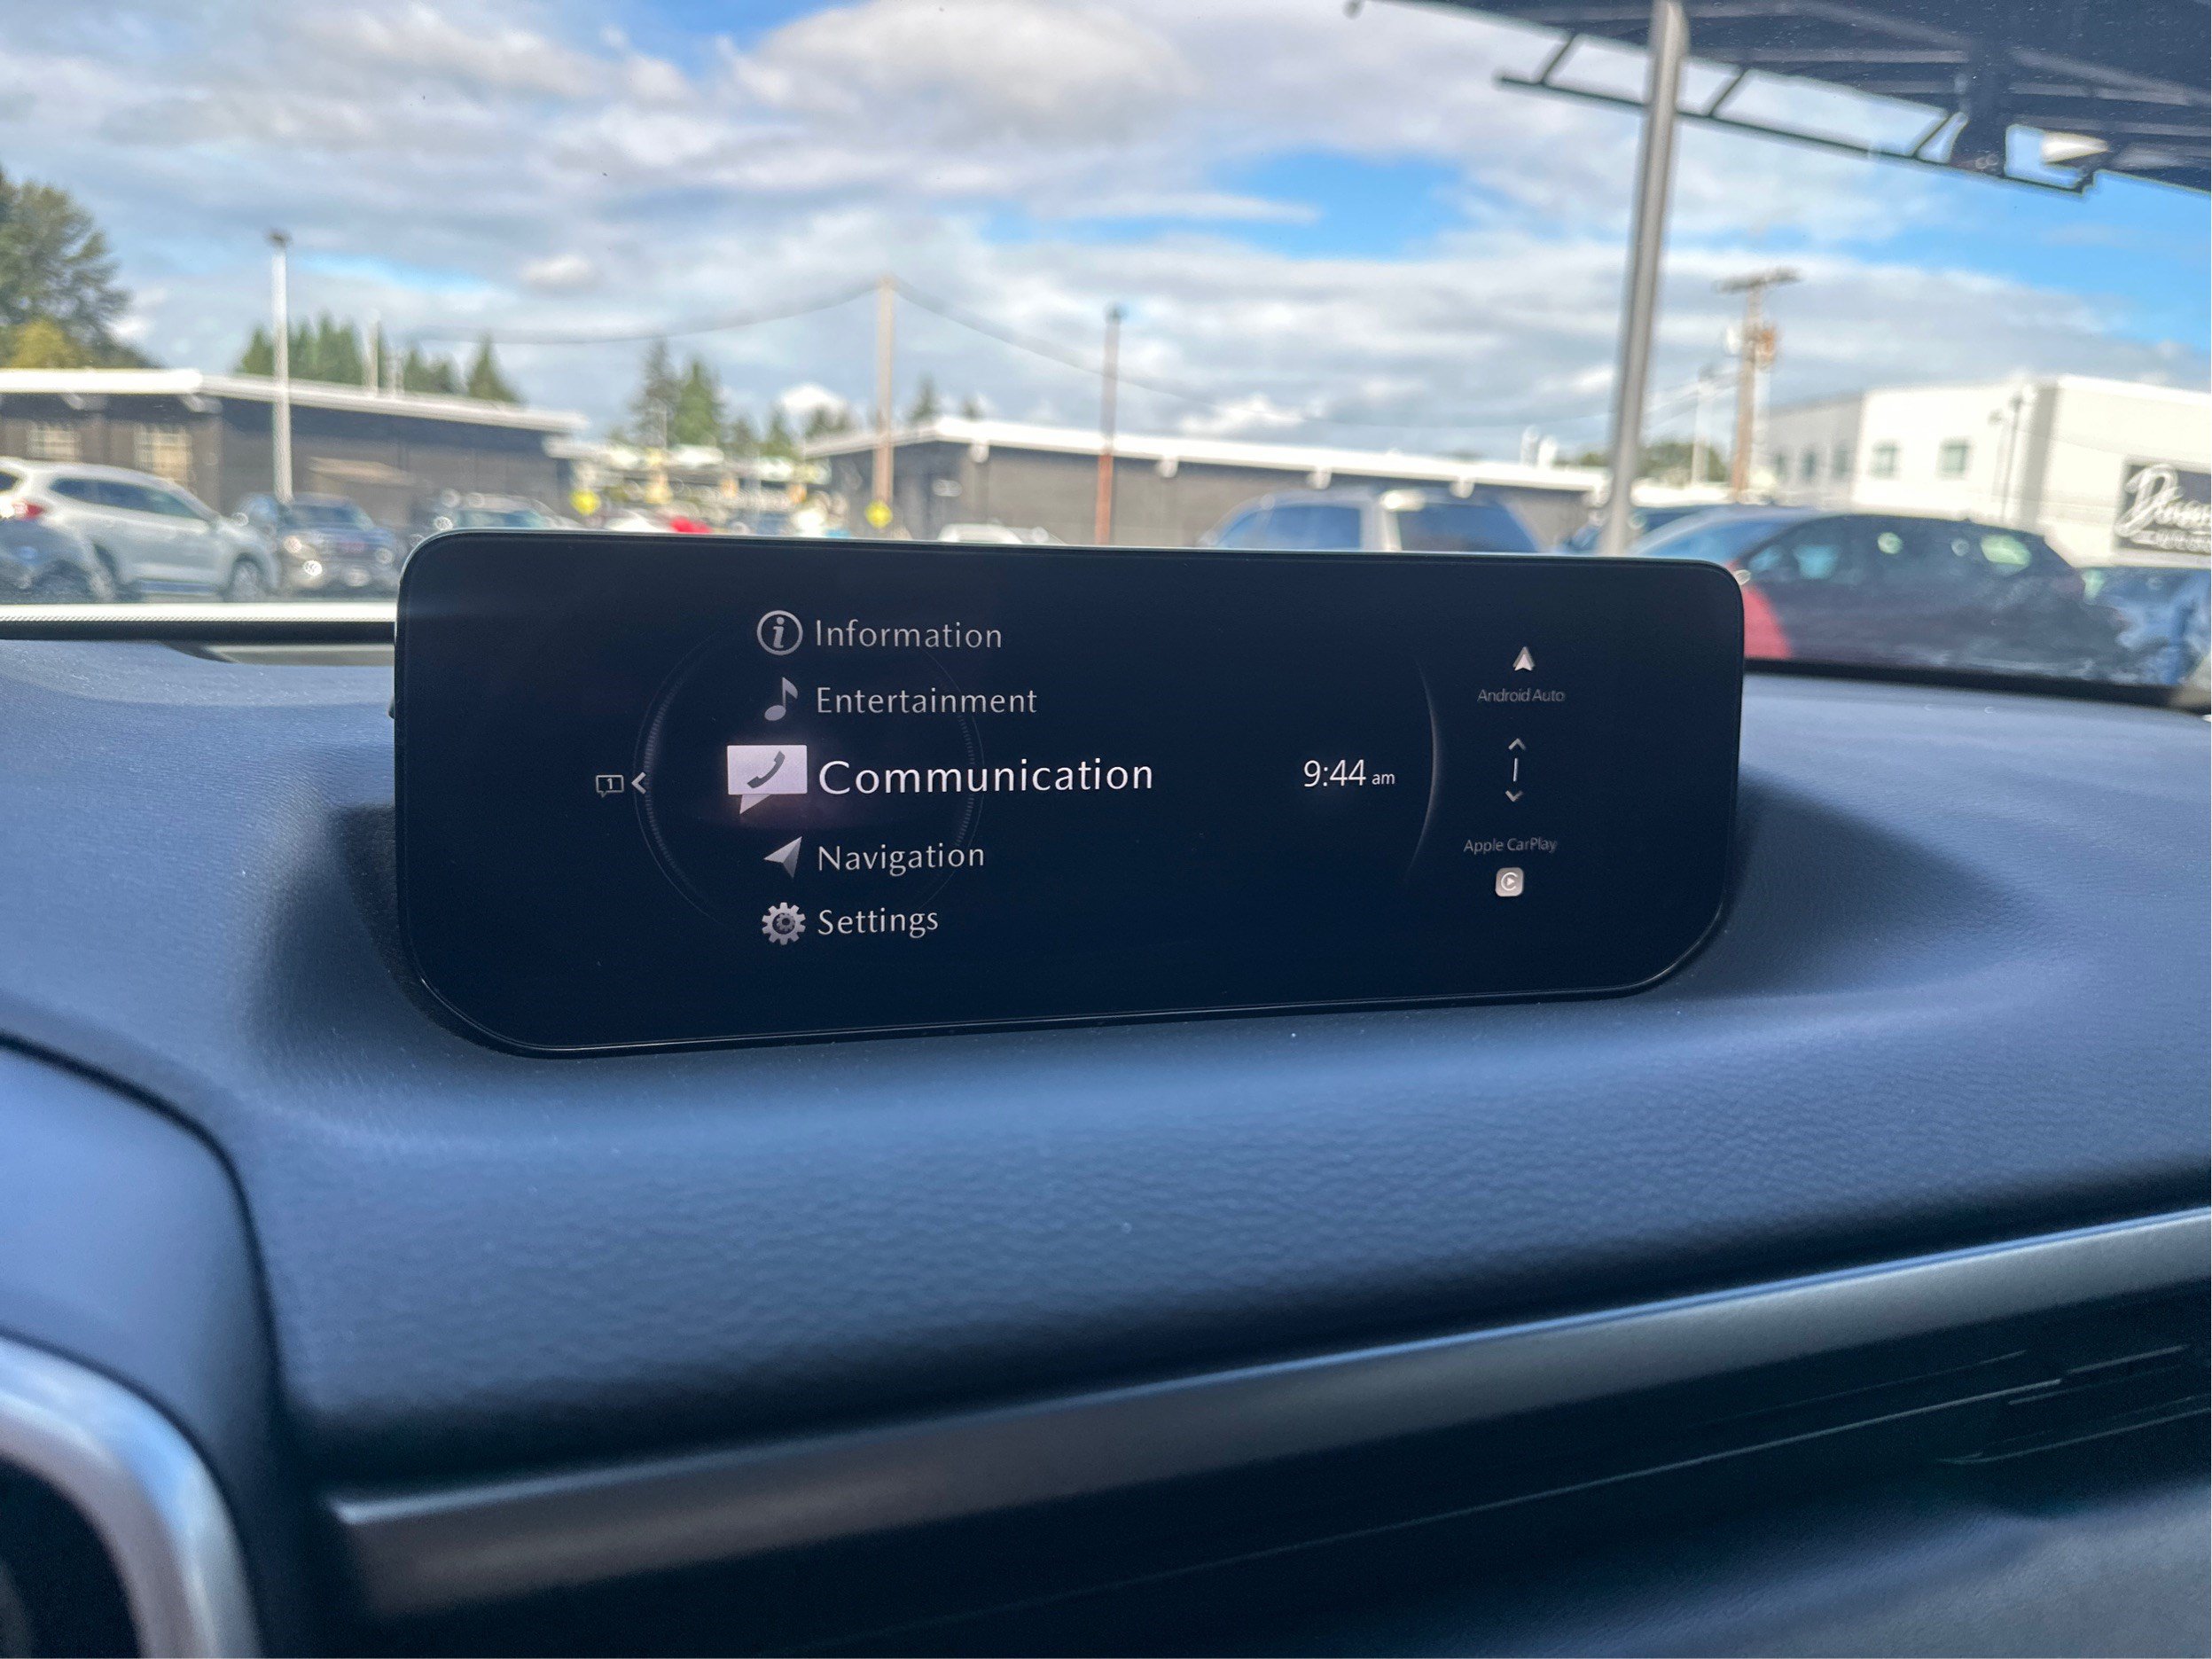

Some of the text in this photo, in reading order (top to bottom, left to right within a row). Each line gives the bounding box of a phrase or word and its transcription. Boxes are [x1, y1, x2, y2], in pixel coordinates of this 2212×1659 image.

[816, 618, 1002, 649] Information
[817, 686, 1037, 715] Entertainment
[1476, 687, 1566, 702] Android Auto
[818, 757, 1153, 795] Communication
[1303, 759, 1396, 787] 9:44 am
[818, 842, 984, 877] Navigation
[1463, 836, 1558, 855] Apple CarPlay
[817, 907, 939, 939] Settings
